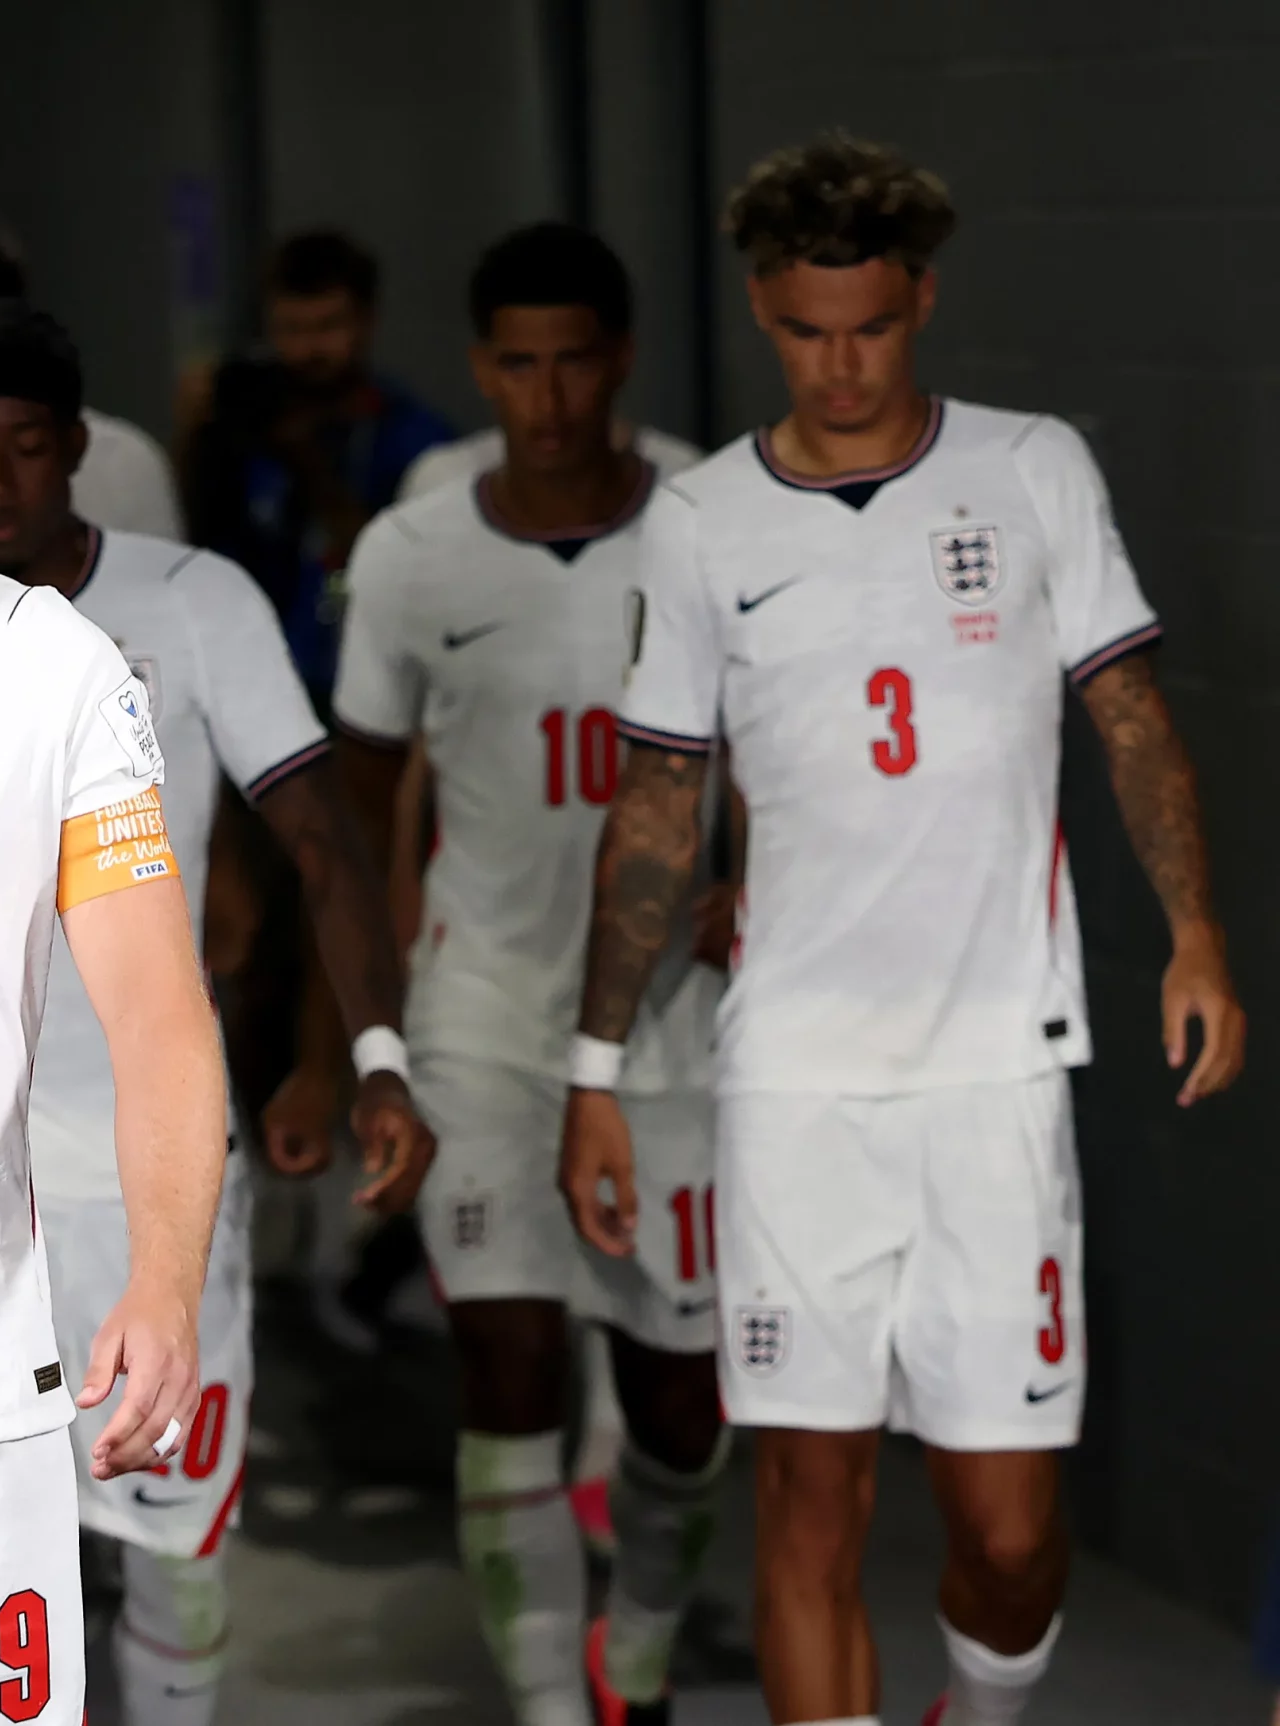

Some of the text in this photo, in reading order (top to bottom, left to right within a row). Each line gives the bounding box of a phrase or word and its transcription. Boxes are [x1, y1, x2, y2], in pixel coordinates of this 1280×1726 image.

[867, 666, 917, 777] 3
[539, 706, 619, 807] 10
[93, 846, 132, 871] the
[97, 809, 164, 847] UNITES
[135, 863, 166, 877] FIFA
[1037, 1256, 1066, 1365] 3
